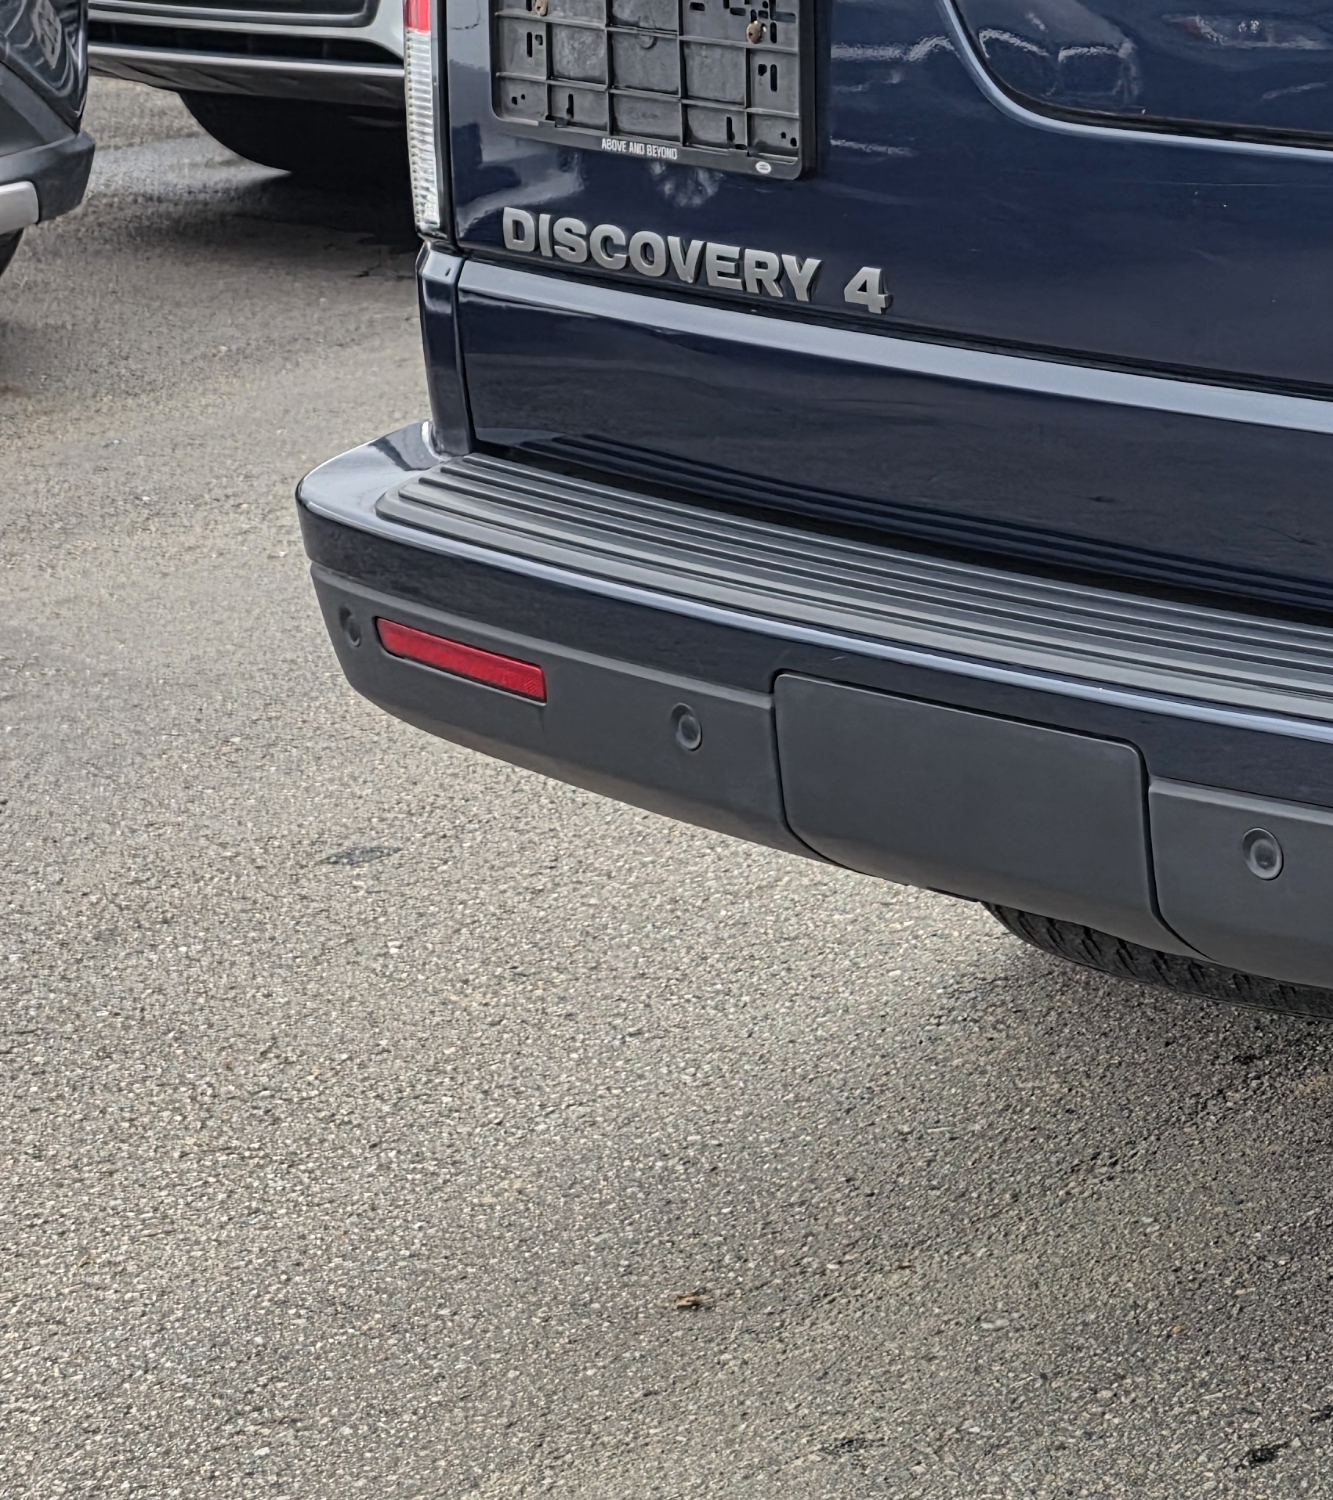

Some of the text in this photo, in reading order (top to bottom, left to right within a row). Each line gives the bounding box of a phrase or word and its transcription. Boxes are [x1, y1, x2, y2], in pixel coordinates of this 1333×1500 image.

[601, 138, 678, 160] ABOVE AND BEYOND
[502, 206, 894, 315] DISCOVERY 4
